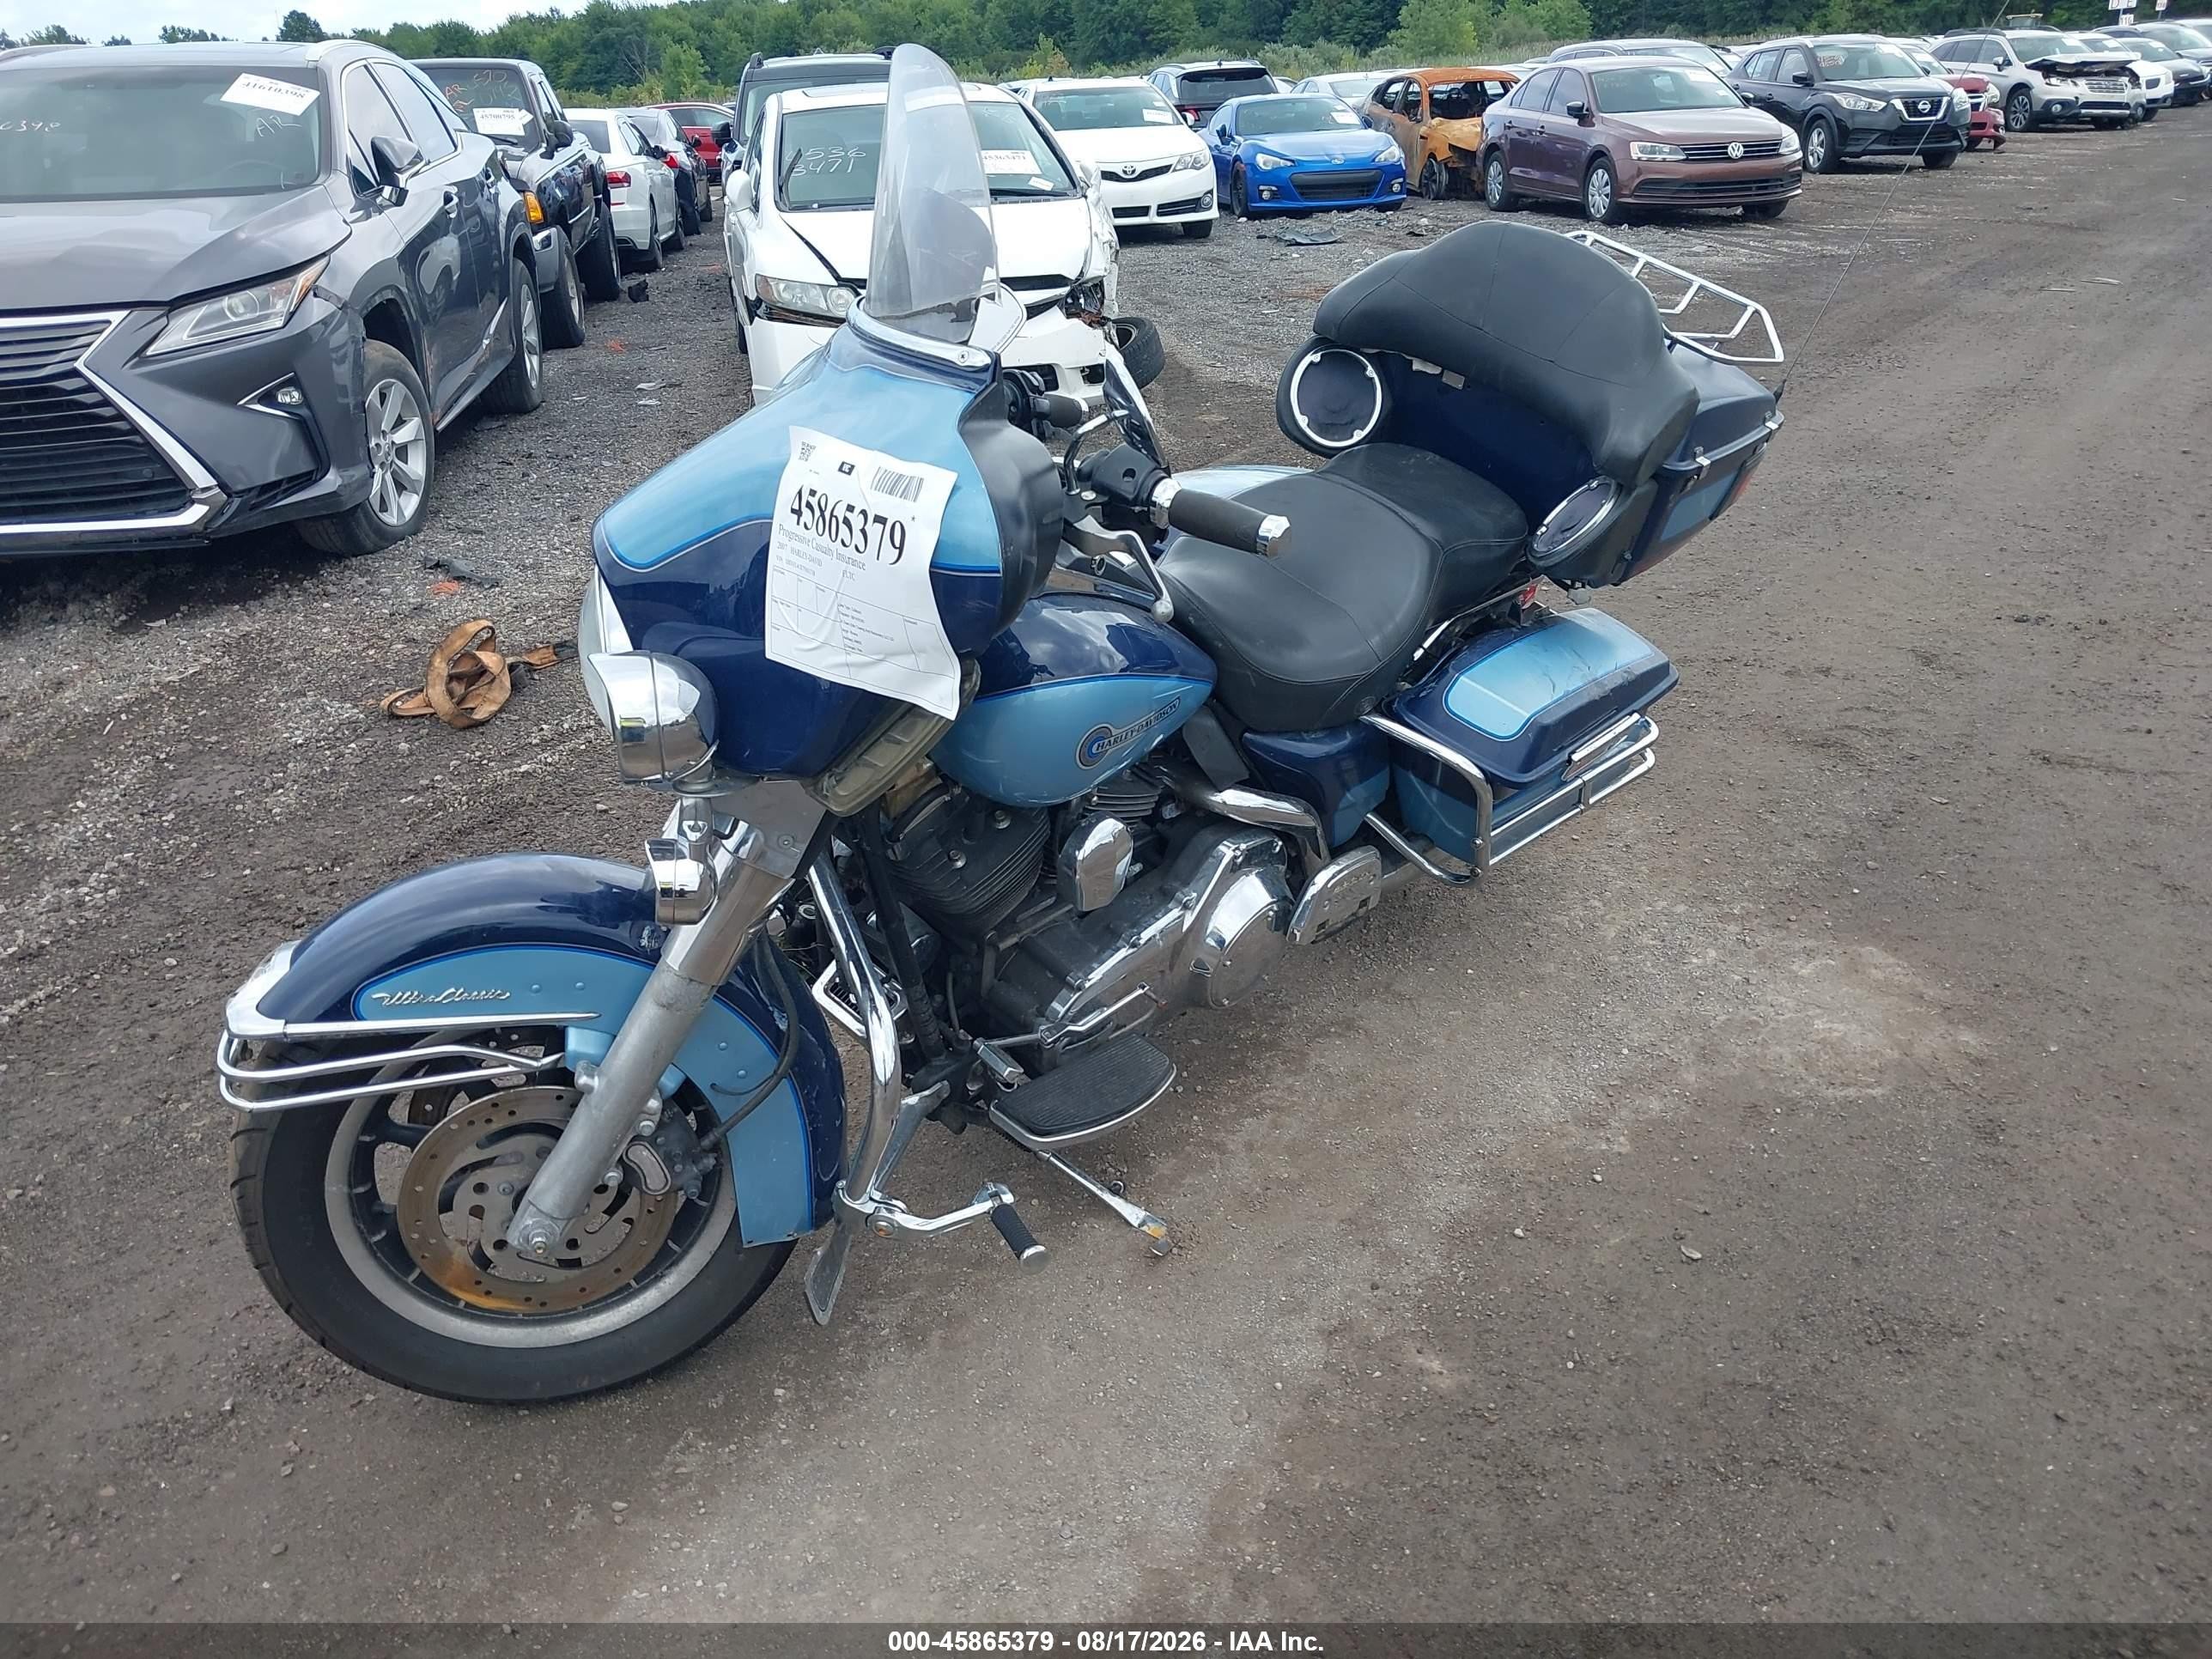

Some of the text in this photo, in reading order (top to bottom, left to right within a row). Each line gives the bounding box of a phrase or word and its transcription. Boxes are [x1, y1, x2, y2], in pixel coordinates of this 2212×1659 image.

[778, 523, 811, 547] Progressive
[811, 537, 834, 561] Casualty
[836, 548, 866, 571] Insurance
[789, 484, 907, 566] 45865379
[1096, 700, 1178, 751] HARLEY-DAVIDSON
